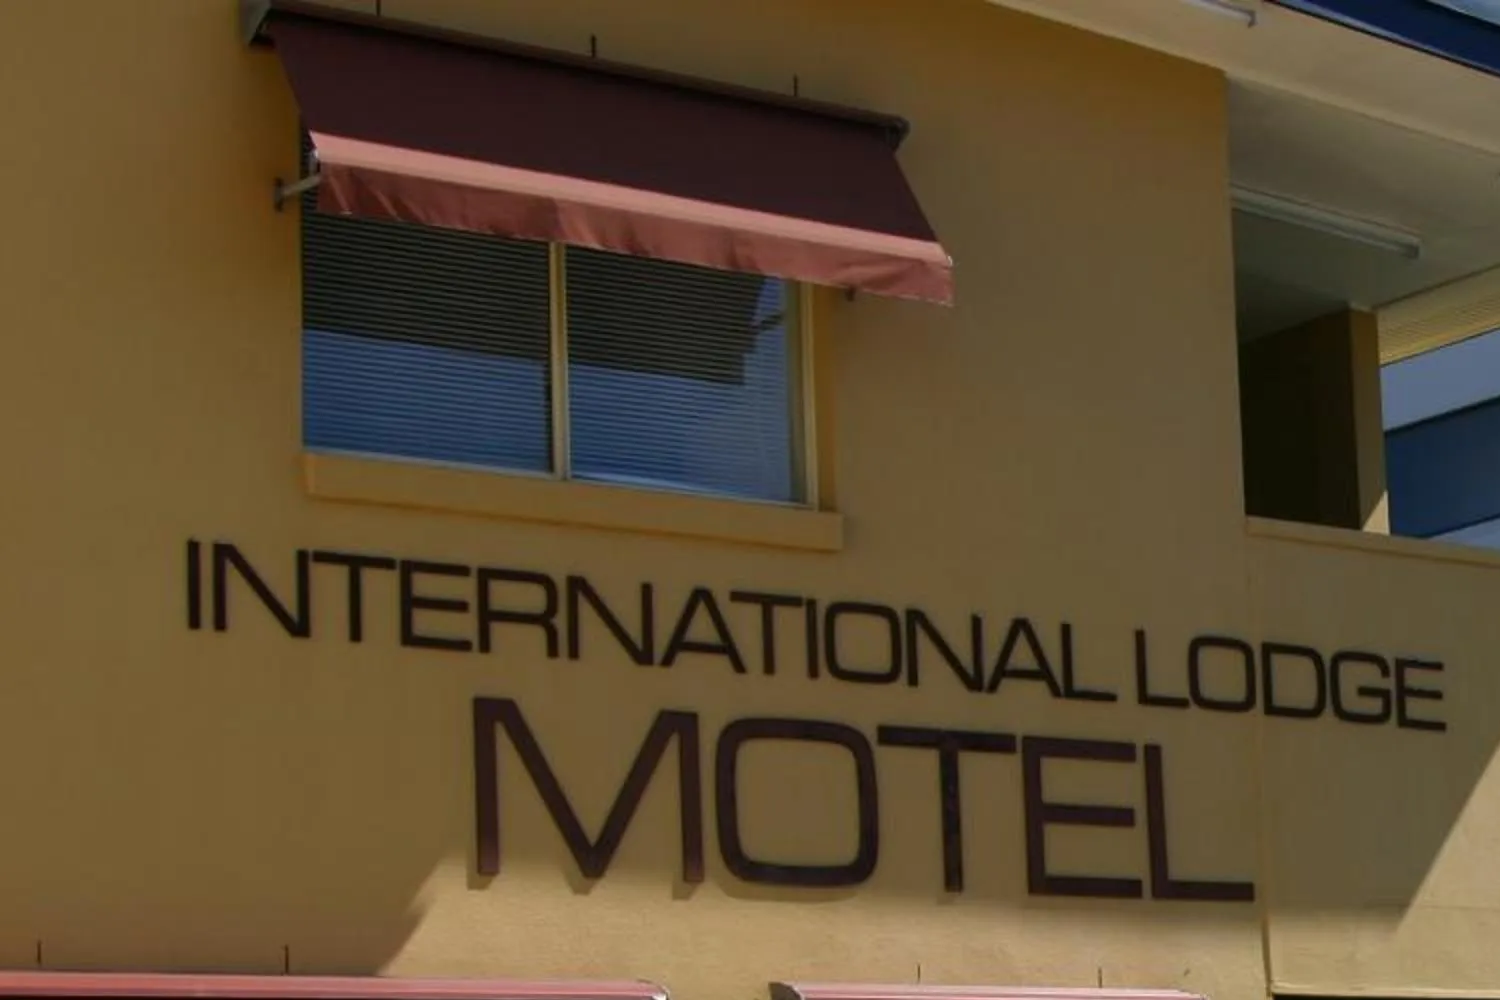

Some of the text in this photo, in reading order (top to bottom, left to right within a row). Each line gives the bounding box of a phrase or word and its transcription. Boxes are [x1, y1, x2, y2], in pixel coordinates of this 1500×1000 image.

[185, 539, 1447, 732] INTERNATIONAL LODGE
[473, 696, 1256, 903] MOTEL
